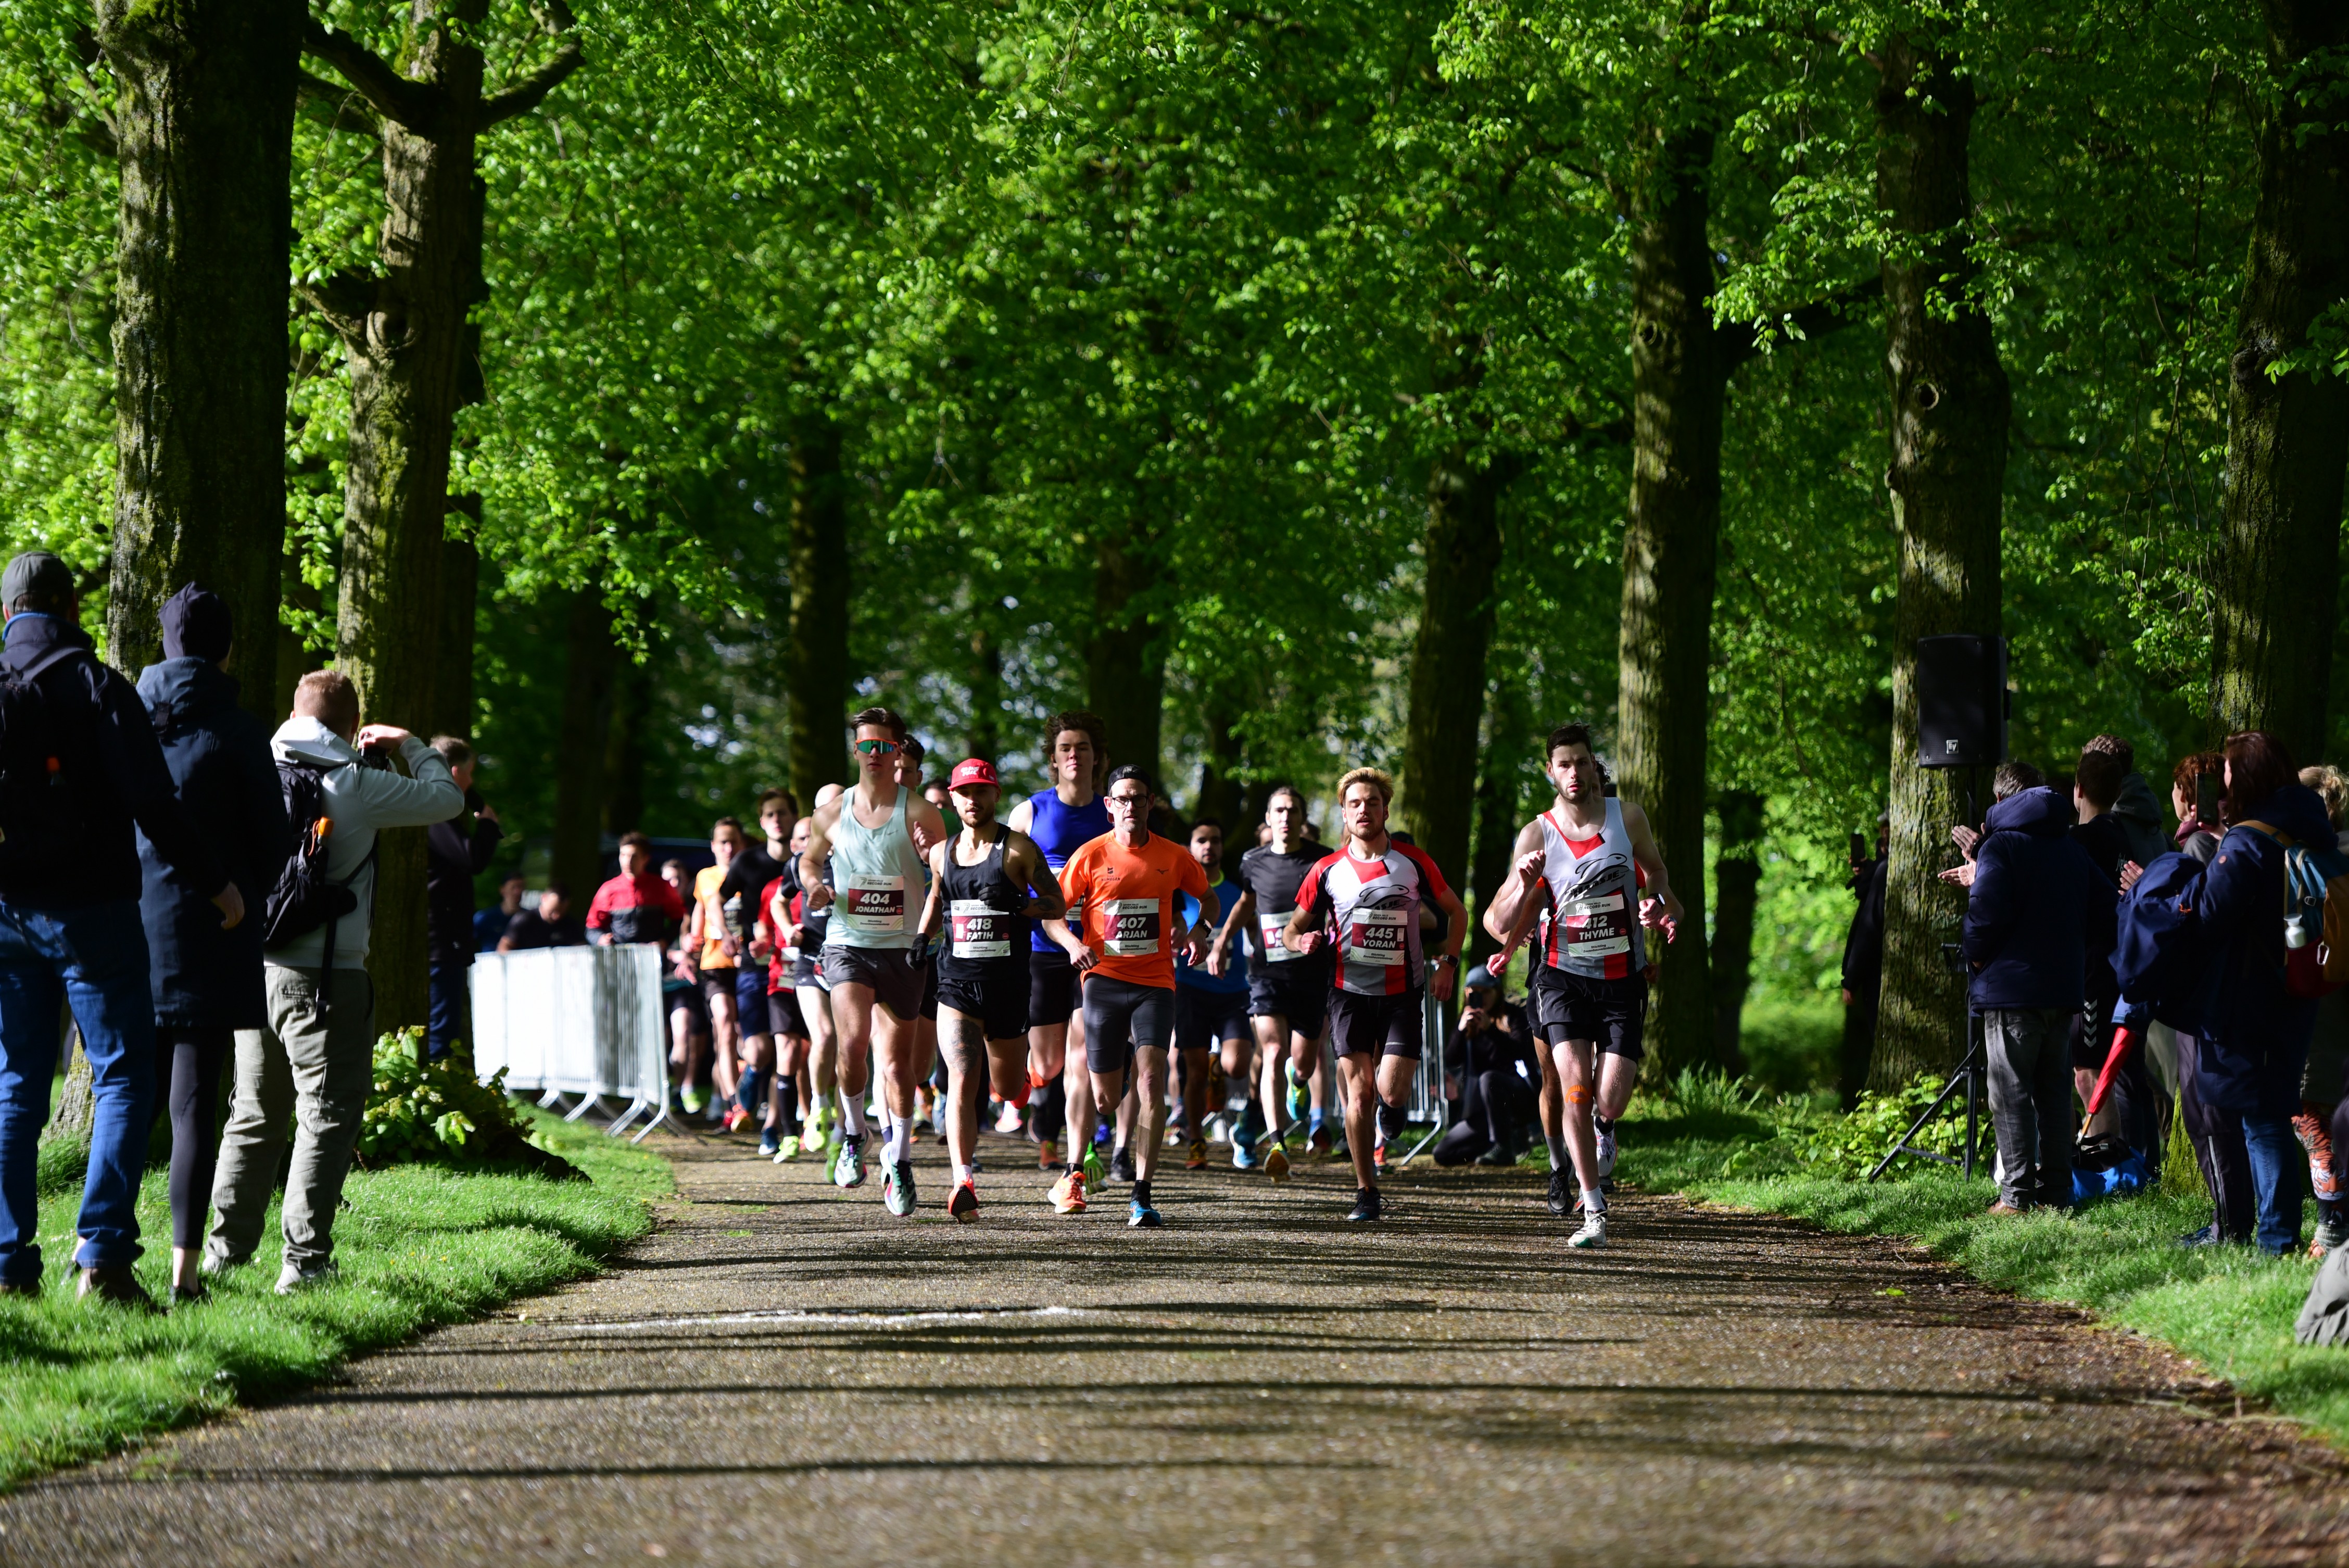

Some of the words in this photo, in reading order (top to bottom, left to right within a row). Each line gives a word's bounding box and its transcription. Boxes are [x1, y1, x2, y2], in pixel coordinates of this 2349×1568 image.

[860, 893, 890, 904] 404
[966, 918, 992, 930] 418
[1117, 917, 1146, 929] 407
[1582, 915, 1608, 929] 412
[966, 931, 994, 940] FATIH
[1115, 930, 1147, 939] ARJAN
[1365, 927, 1394, 939] 445
[1579, 927, 1614, 941] THYME
[1362, 939, 1396, 949] YORAN
